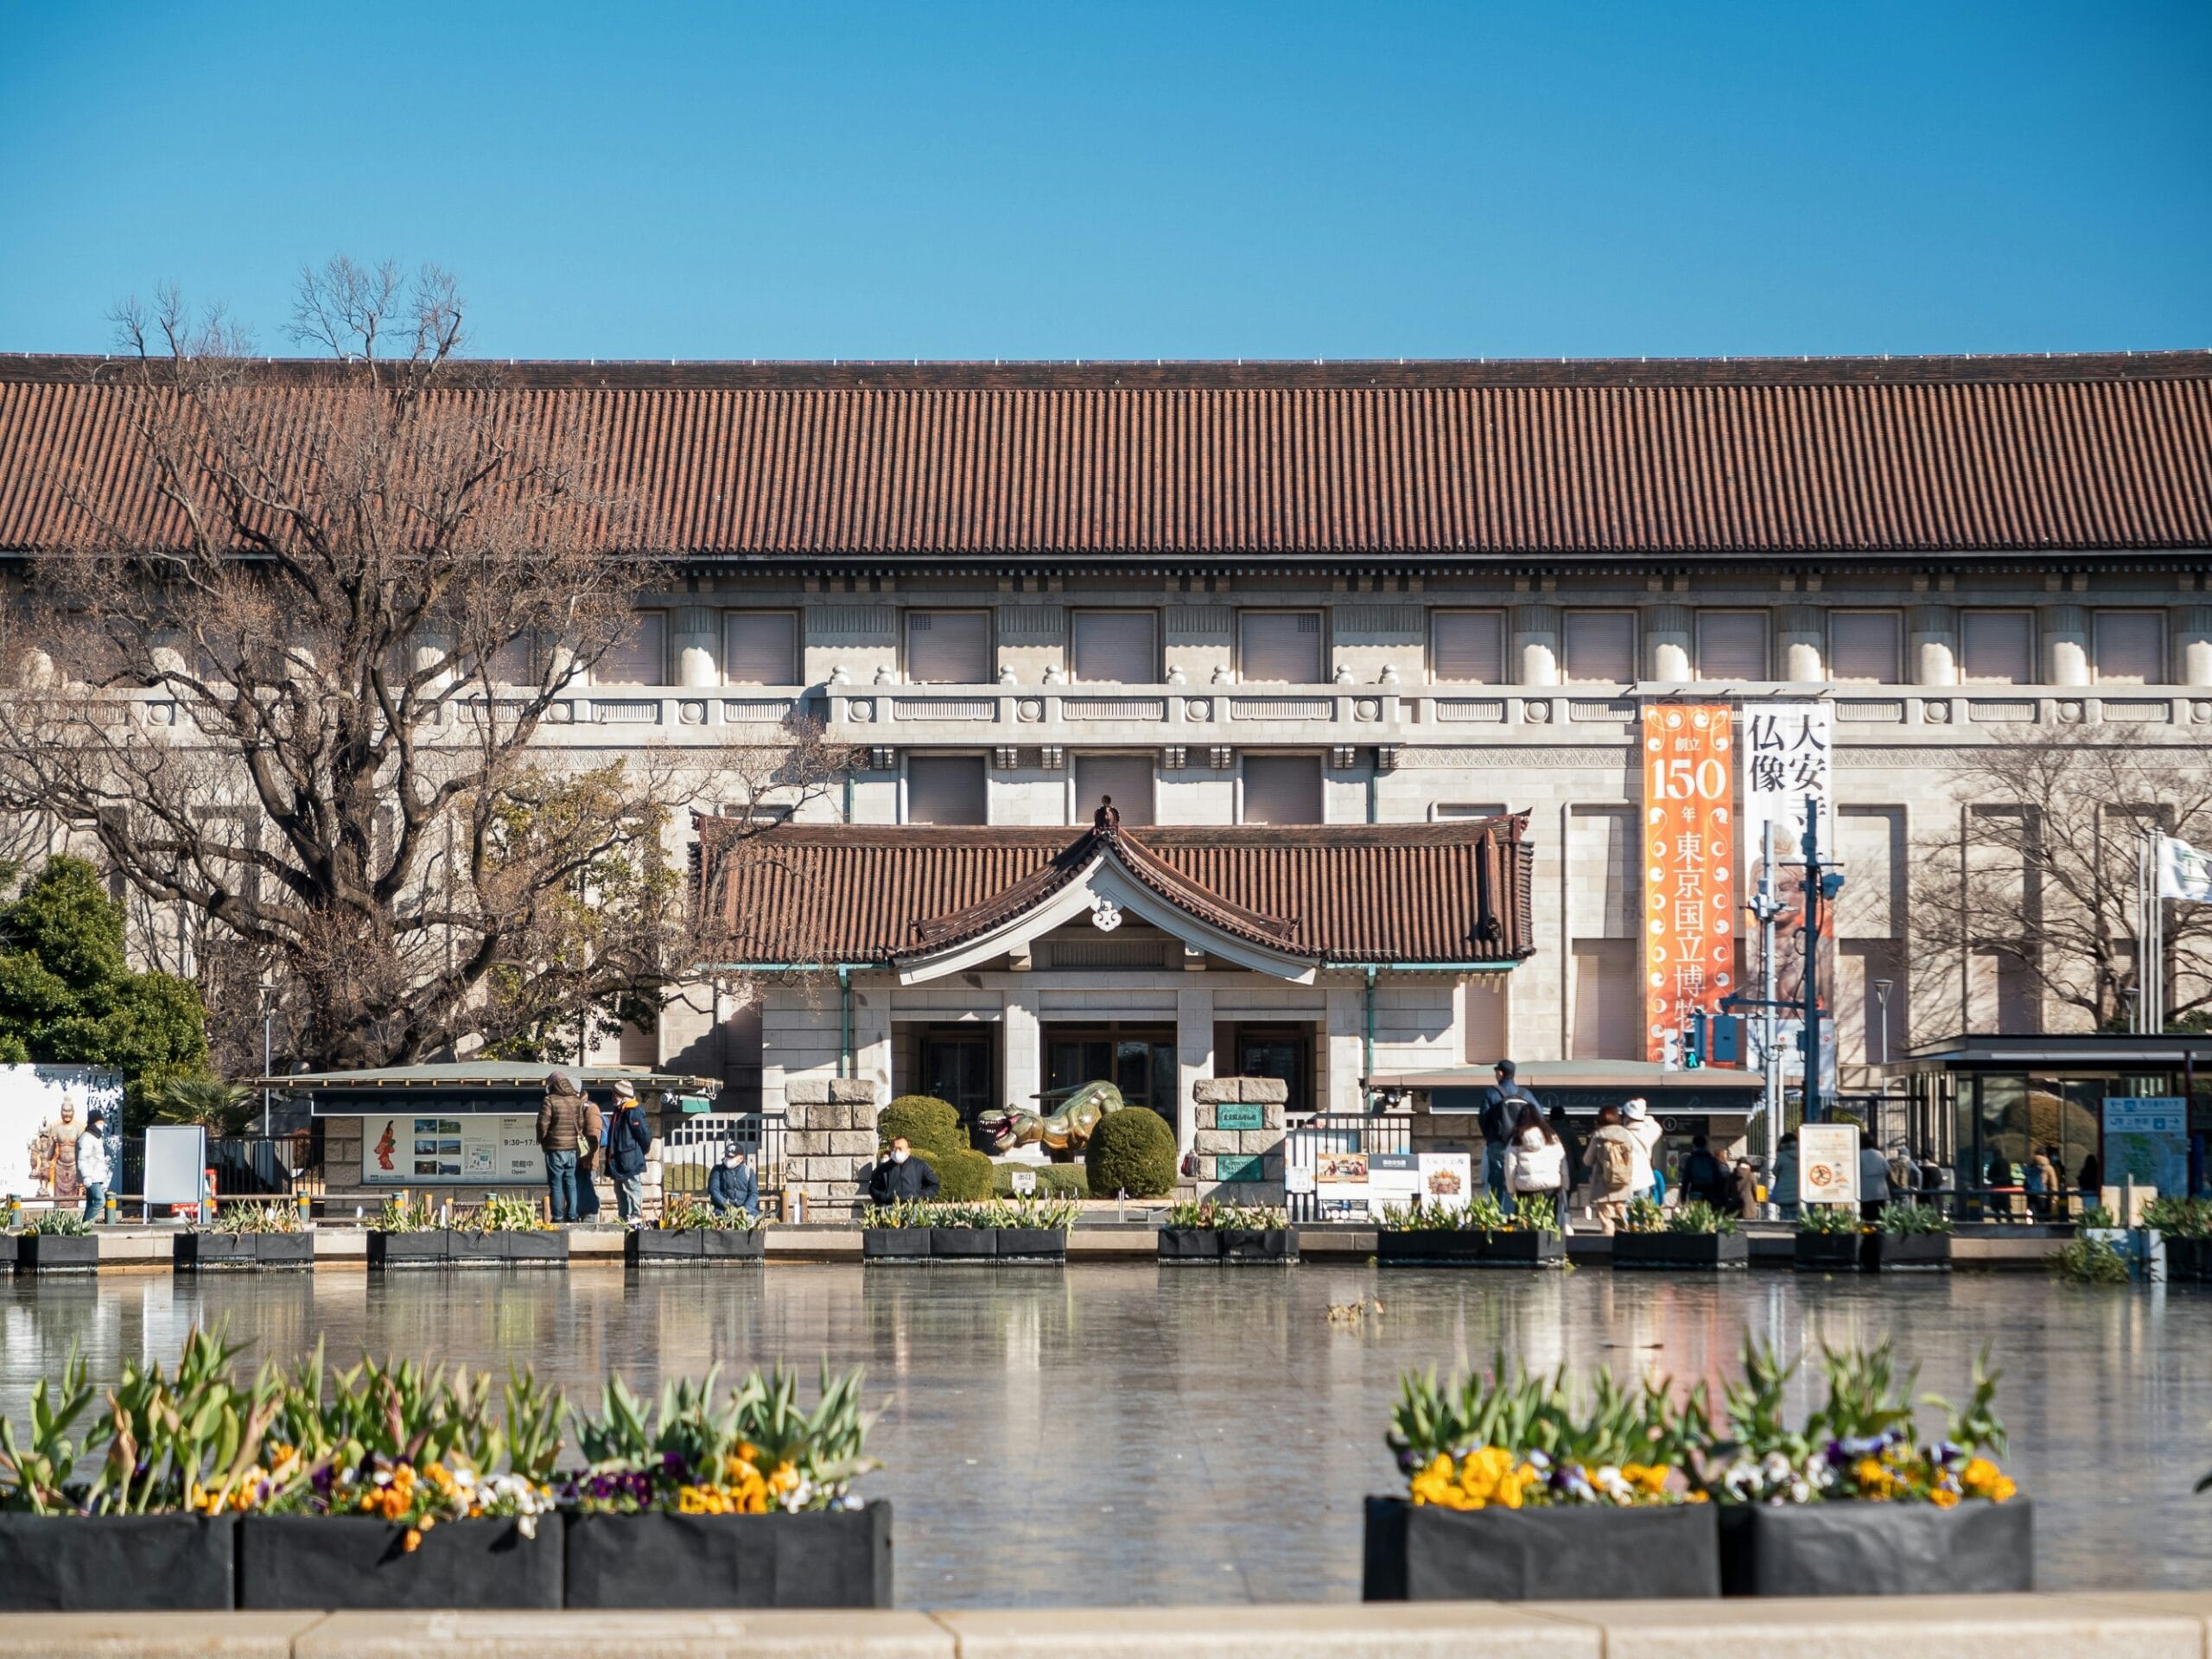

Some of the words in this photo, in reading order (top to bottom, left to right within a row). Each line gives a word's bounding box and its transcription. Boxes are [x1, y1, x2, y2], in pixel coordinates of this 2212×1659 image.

[1674, 737, 1701, 752] 創立
[1747, 714, 1786, 792] 仏像
[1650, 759, 1726, 800] 150
[1680, 806, 1697, 823] 年
[1673, 830, 1707, 1065] 東京国立博物
